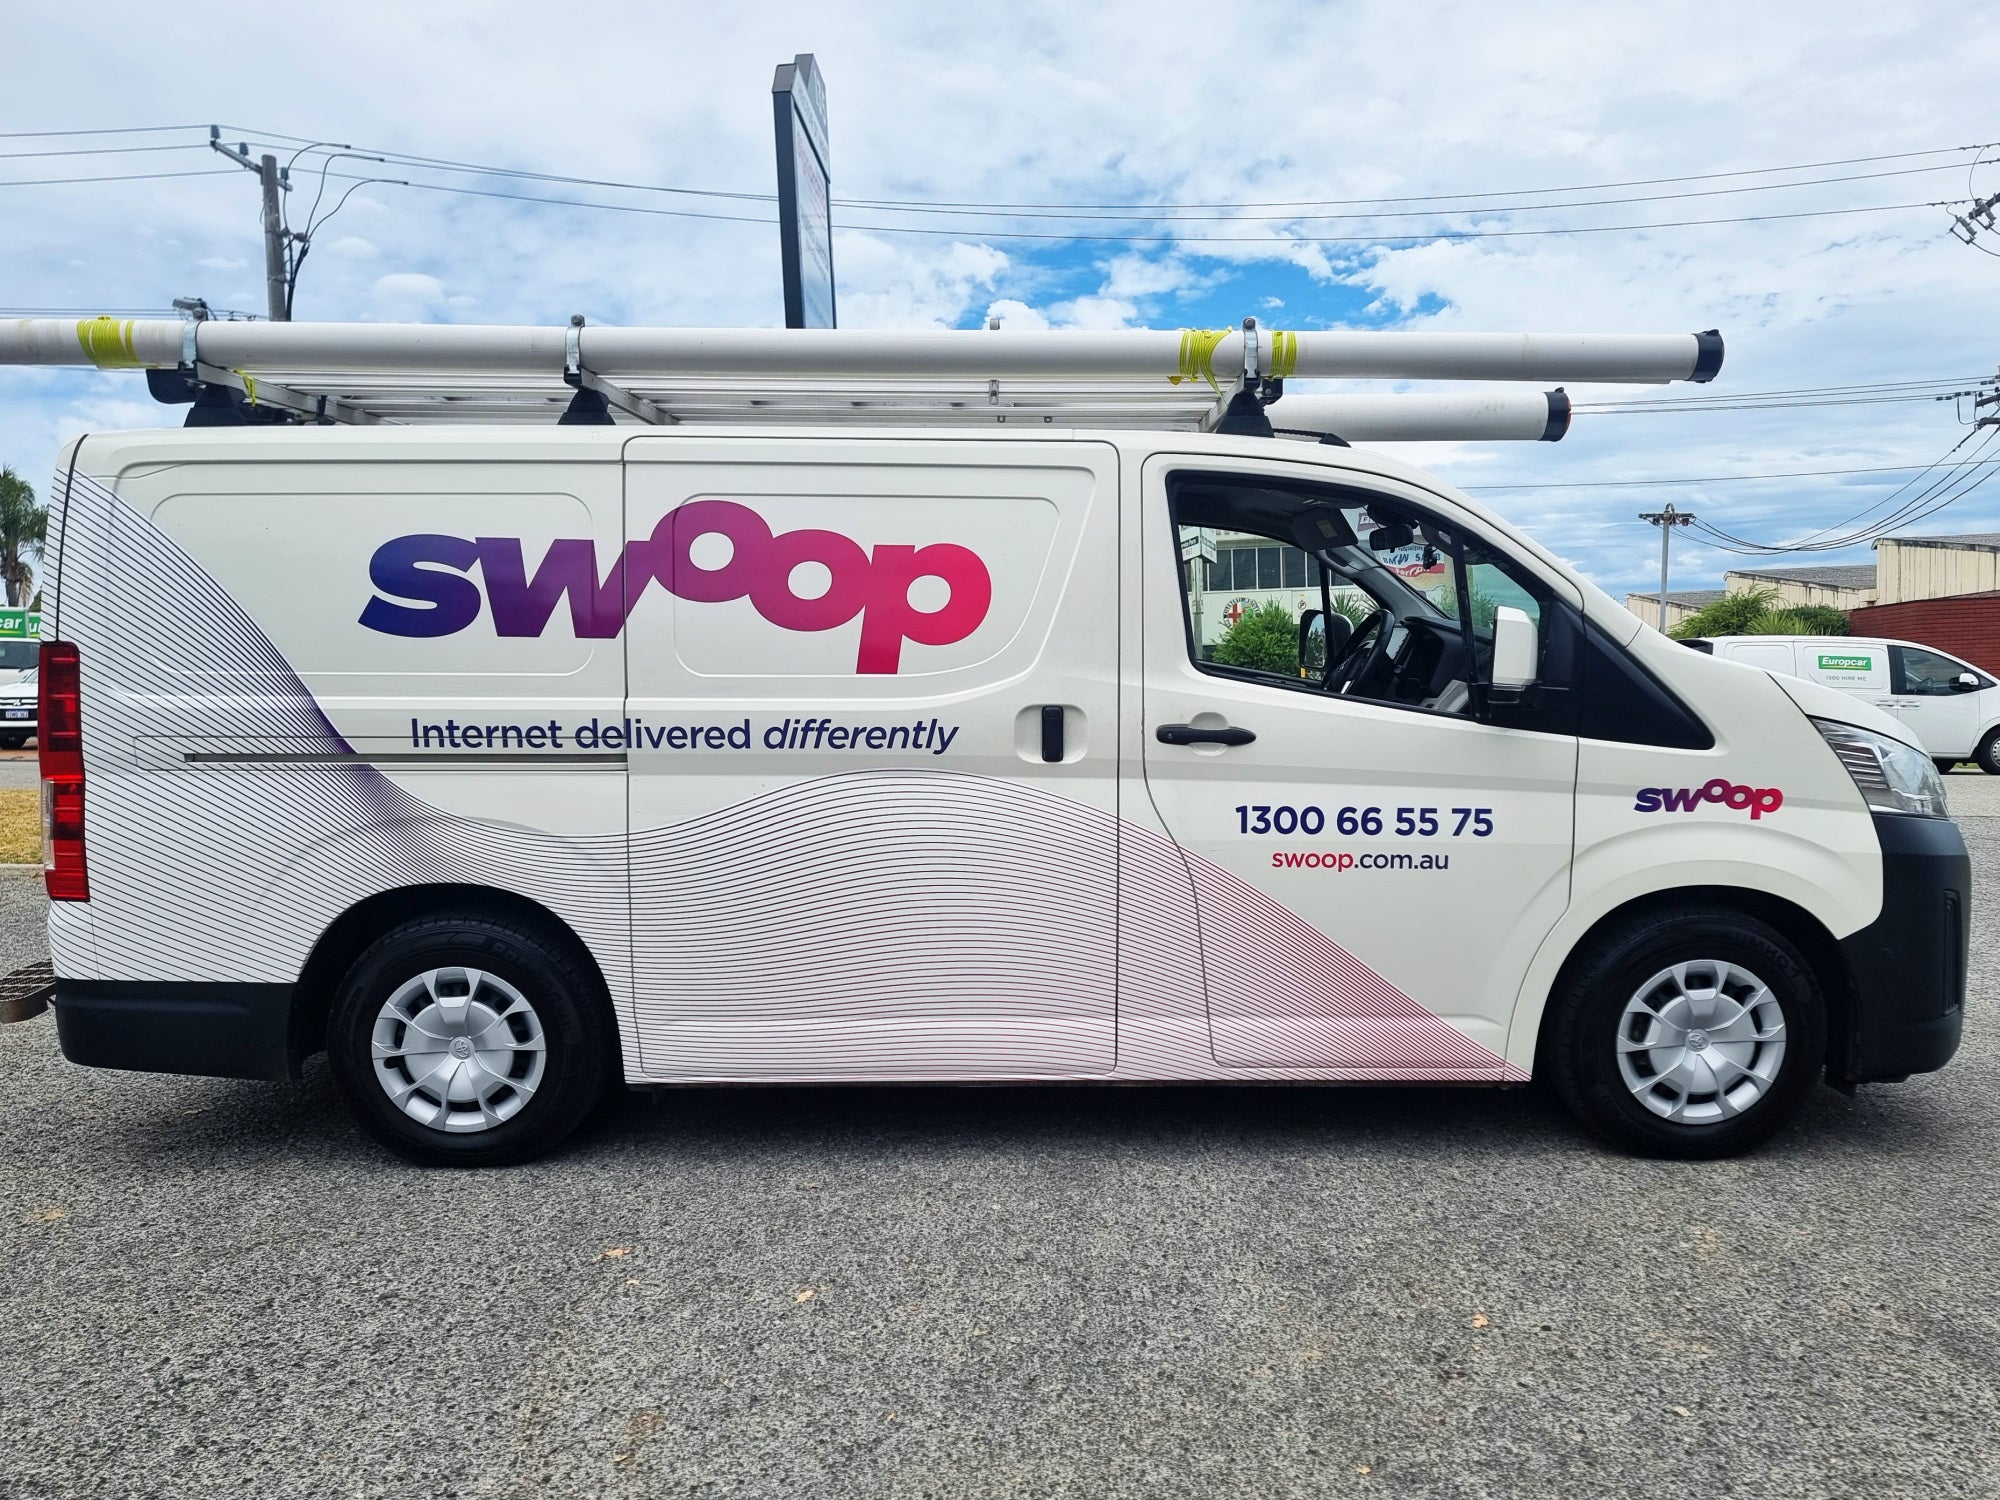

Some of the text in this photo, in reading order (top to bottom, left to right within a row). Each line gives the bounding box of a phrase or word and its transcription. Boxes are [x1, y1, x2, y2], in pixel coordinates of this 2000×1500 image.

[358, 500, 993, 675] swoop
[1821, 656, 1868, 668] Europcar
[411, 718, 960, 754] Internet delivered differently
[1633, 778, 1784, 821] swoop
[1236, 806, 1493, 837] 1300 66 55 75
[1272, 852, 1449, 873] swoop.com.au
